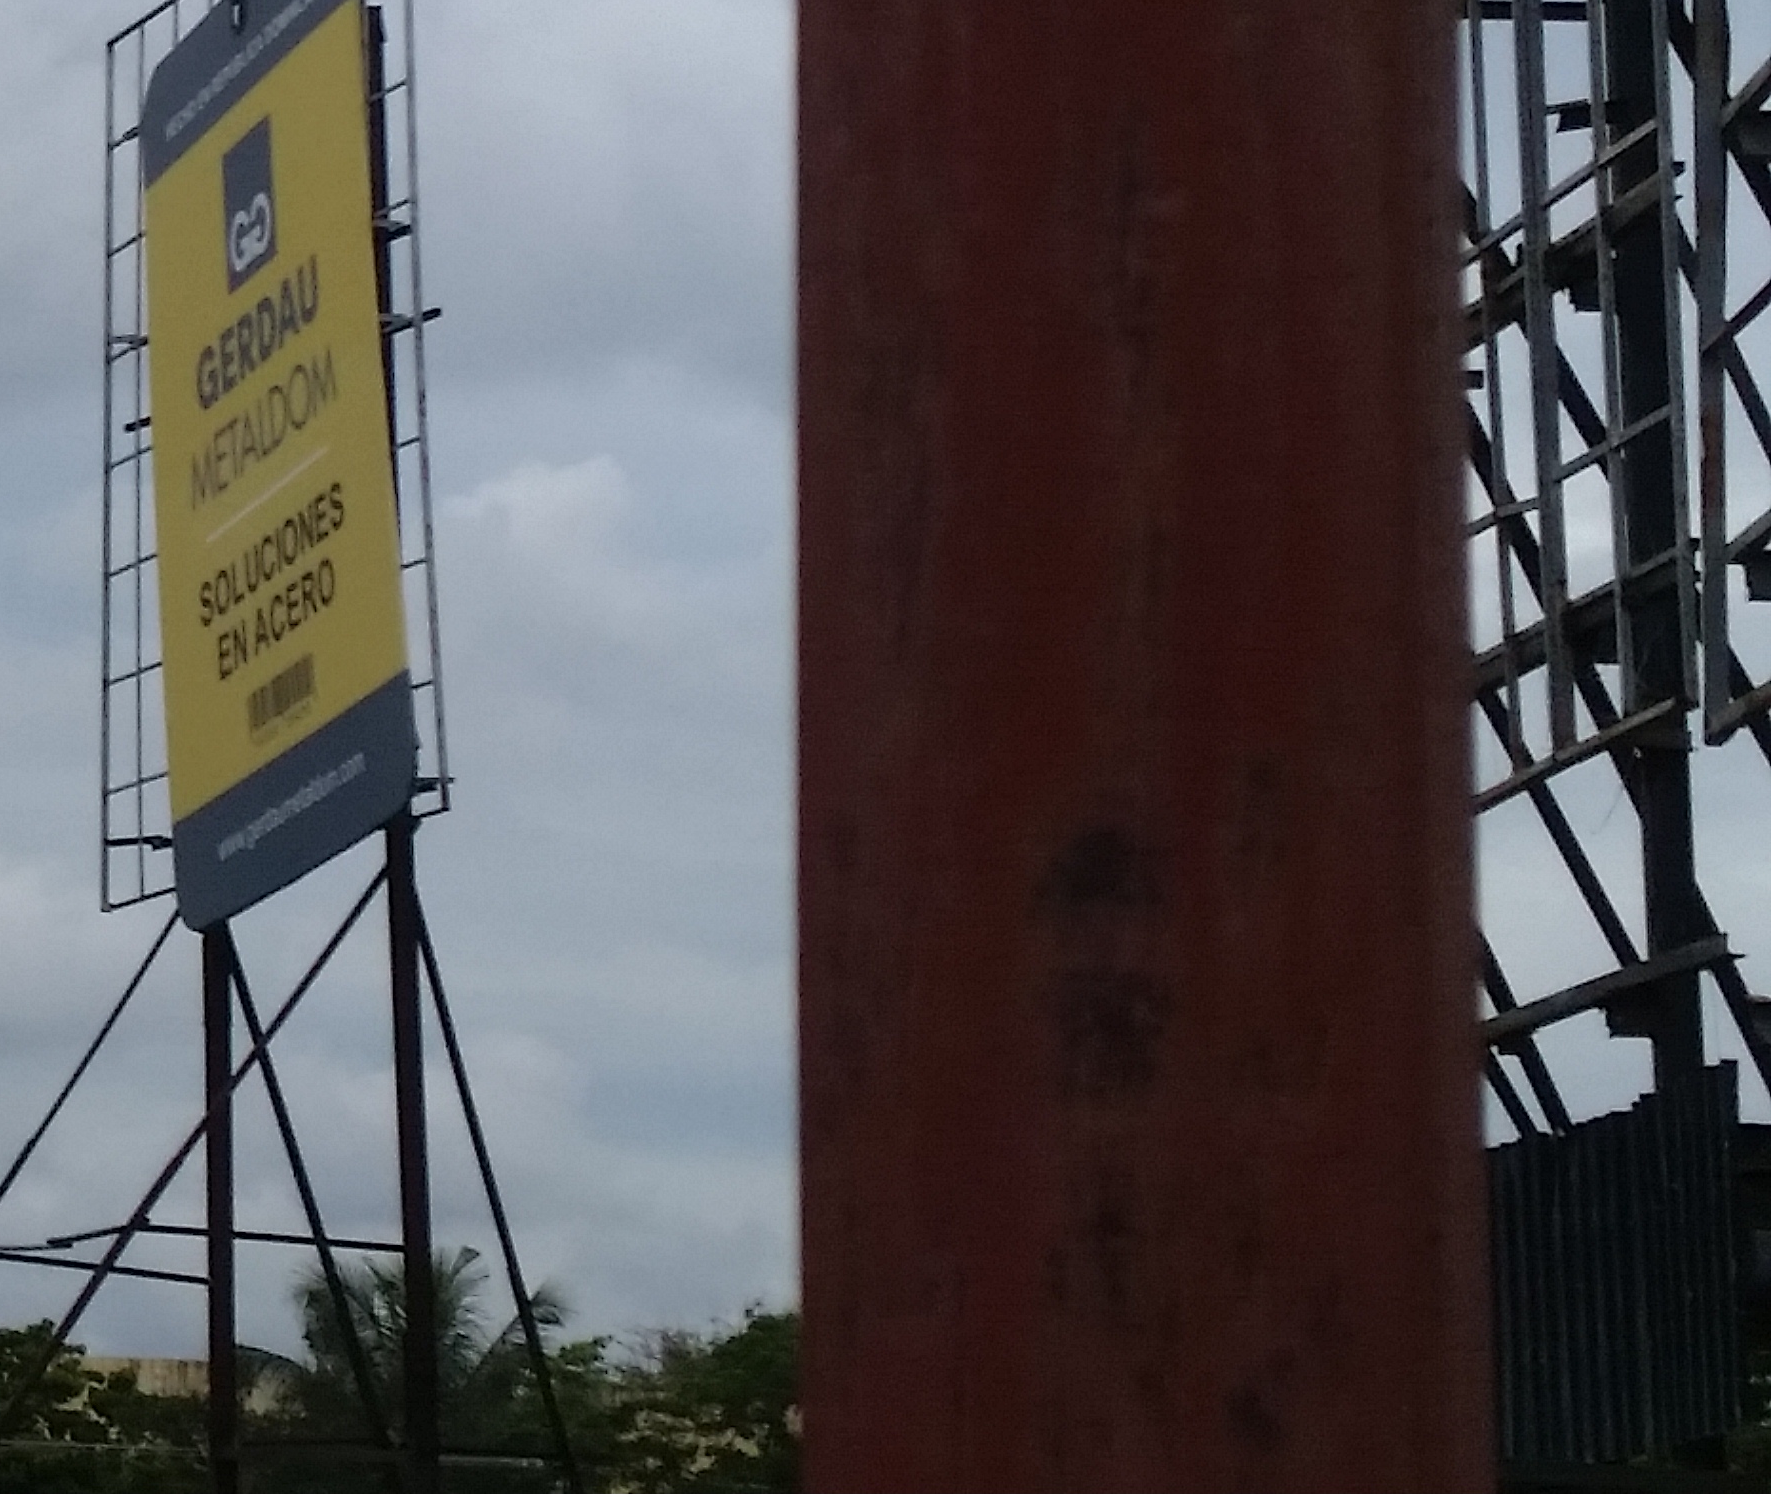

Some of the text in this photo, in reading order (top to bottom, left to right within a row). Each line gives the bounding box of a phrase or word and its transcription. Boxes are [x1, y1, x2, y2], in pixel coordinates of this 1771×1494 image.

[196, 254, 319, 410] GERDAU
[191, 348, 336, 511] METALDOM
[199, 481, 344, 628] SOLUCIONES
[218, 557, 335, 681] EN ACERO
